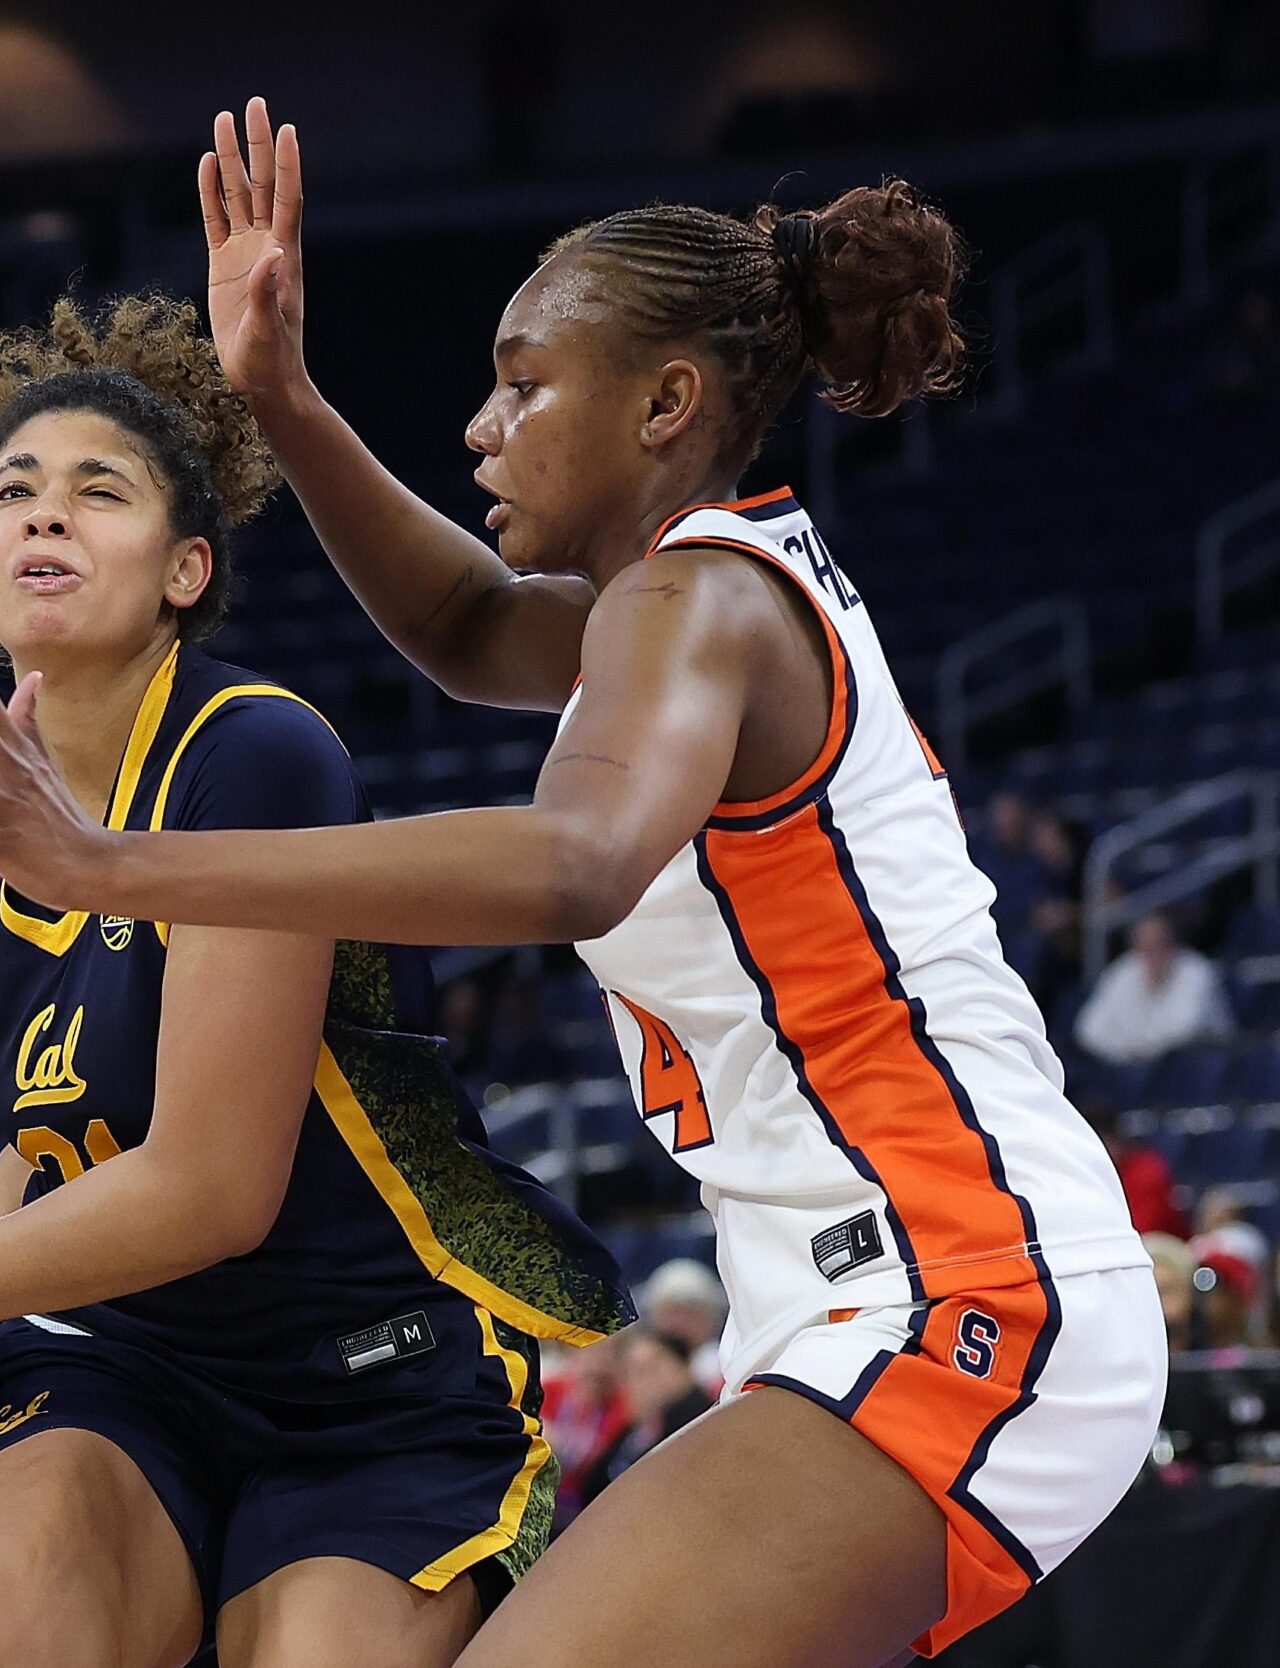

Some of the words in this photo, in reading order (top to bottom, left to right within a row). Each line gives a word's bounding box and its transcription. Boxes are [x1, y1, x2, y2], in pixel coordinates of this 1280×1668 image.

[13, 1003, 87, 1112] Cal
[600, 988, 715, 1155] 4
[857, 1228, 868, 1248] L
[403, 1324, 422, 1344] M
[953, 1309, 1001, 1379] S
